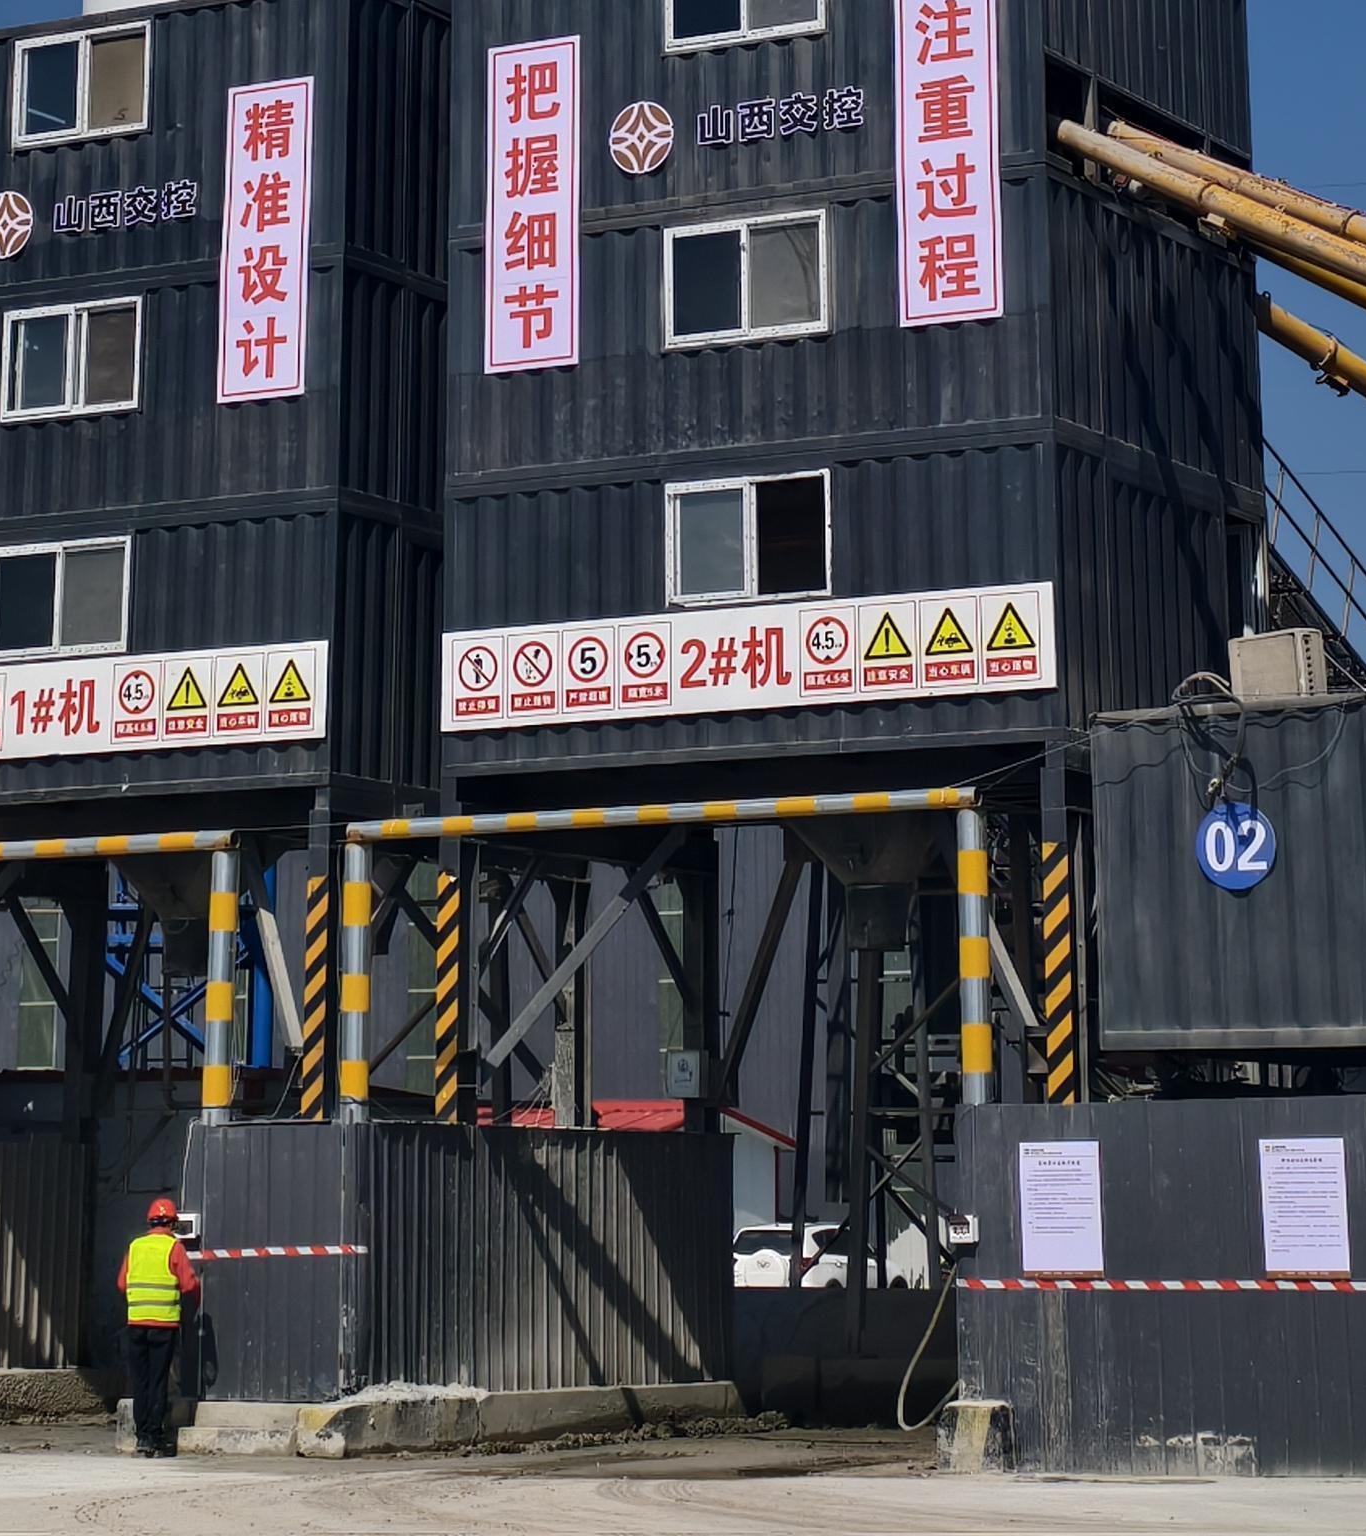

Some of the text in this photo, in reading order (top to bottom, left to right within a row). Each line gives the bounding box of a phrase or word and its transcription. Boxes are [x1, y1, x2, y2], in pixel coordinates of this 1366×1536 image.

[697, 86, 864, 146] 山西交控
[53, 179, 197, 233] 山西交控
[504, 61, 561, 349] 把握细节
[235, 99, 295, 379] 精准设计
[579, 647, 597, 675] 5
[680, 626, 792, 689] 2#机
[10, 678, 101, 736] 1#机
[1205, 819, 1268, 872] 02
